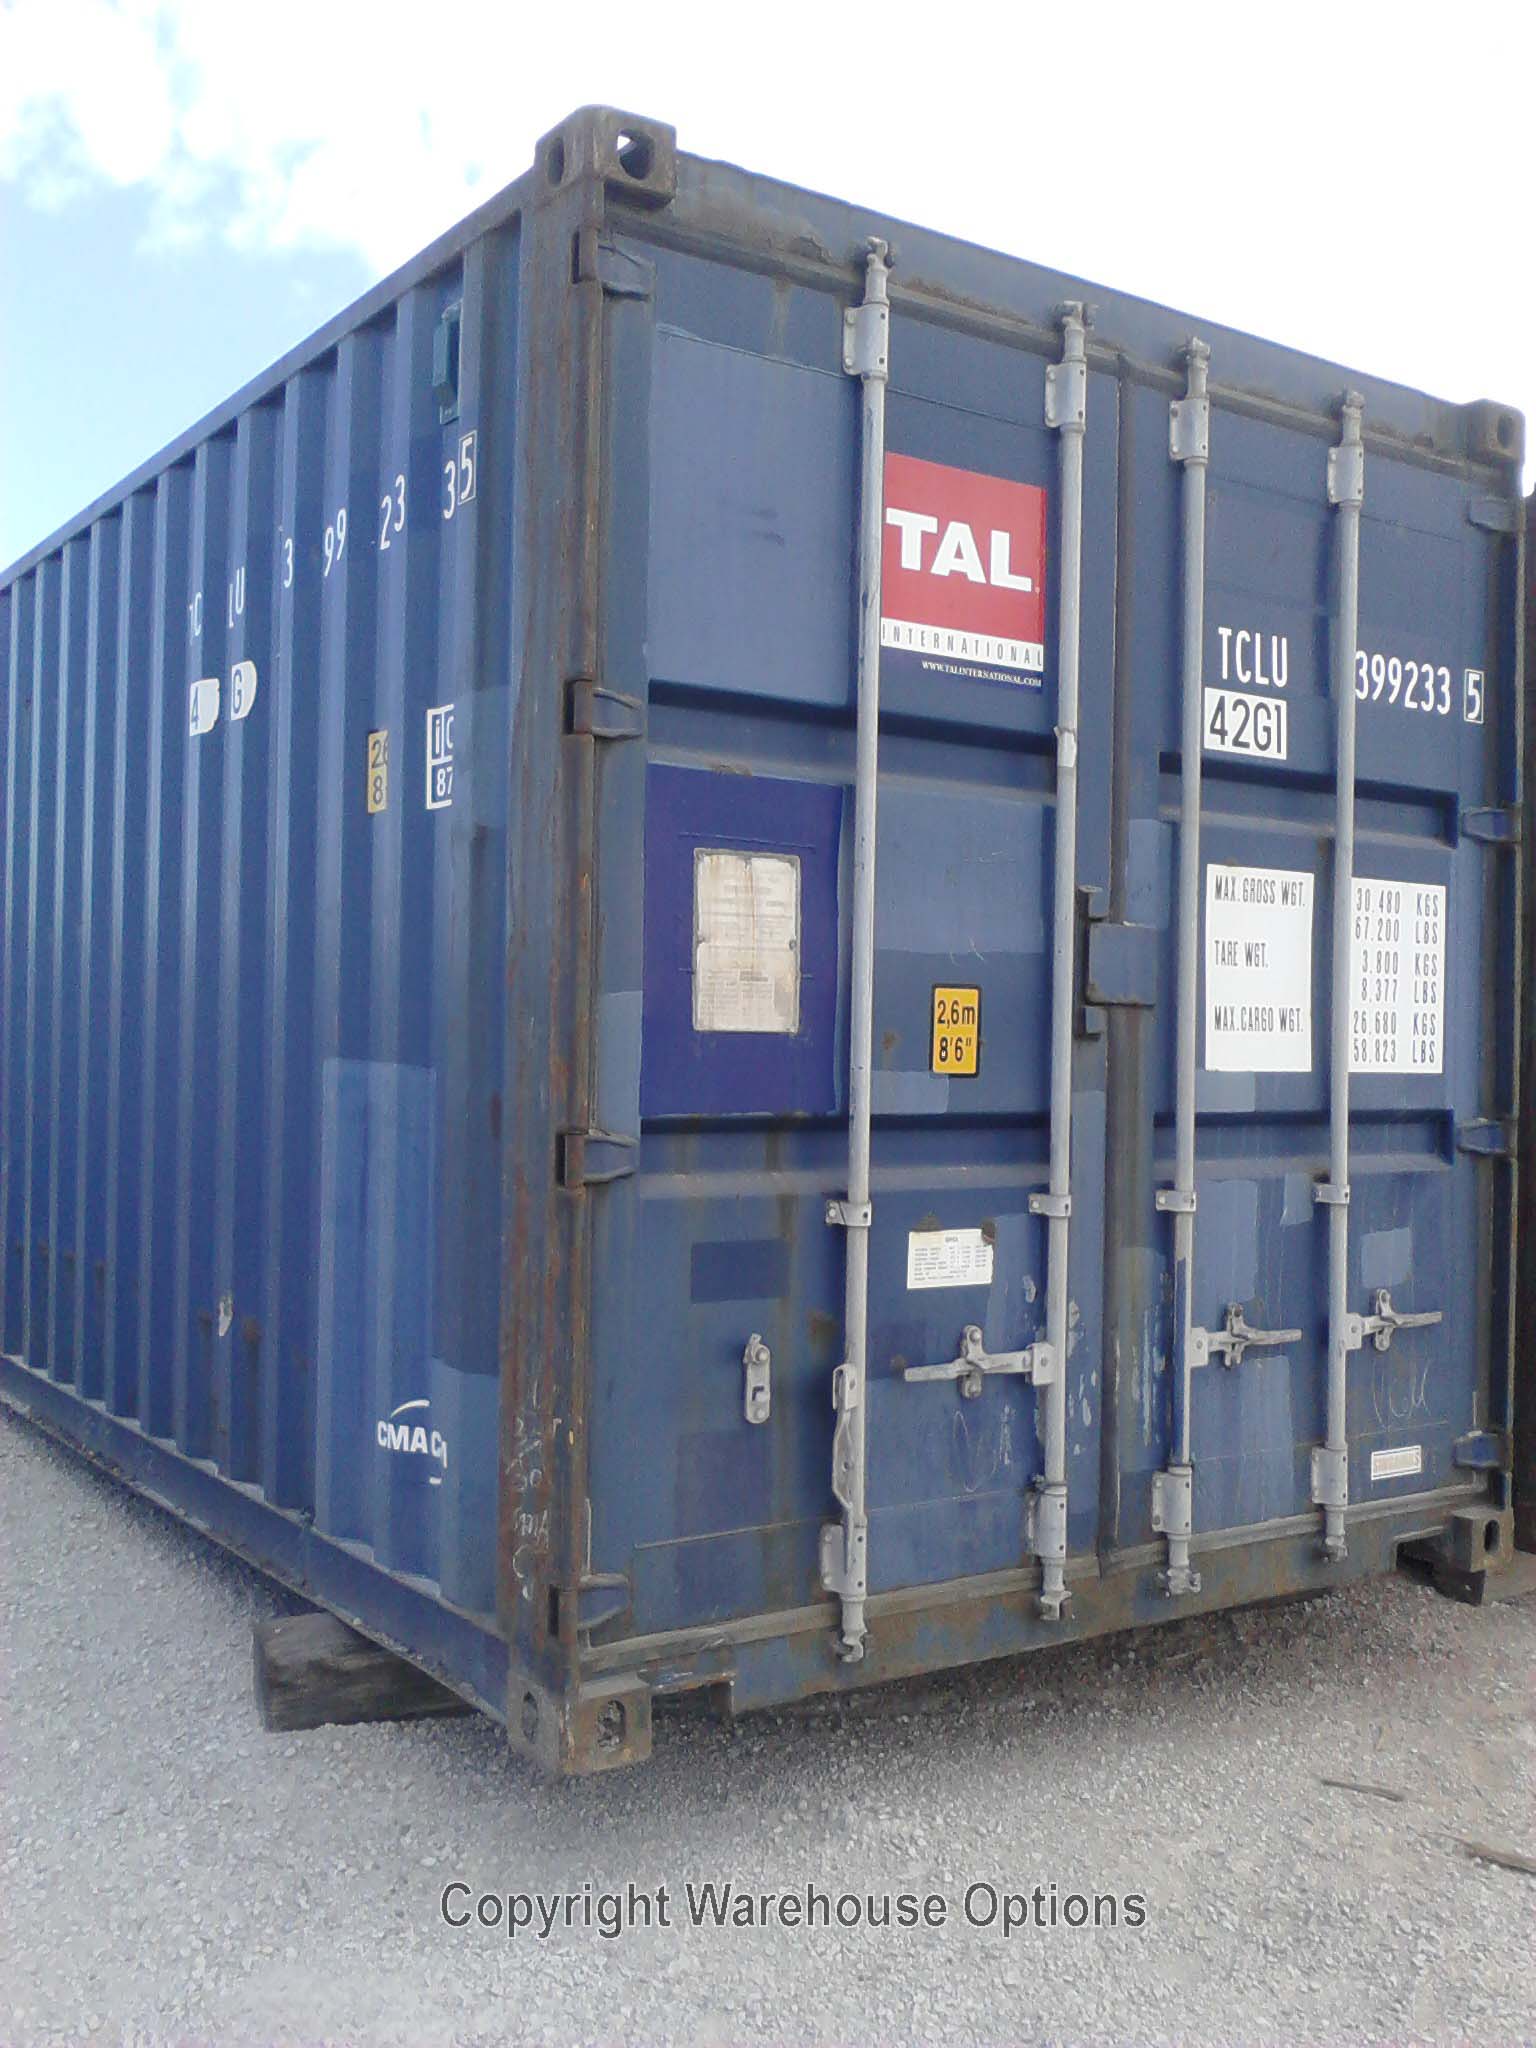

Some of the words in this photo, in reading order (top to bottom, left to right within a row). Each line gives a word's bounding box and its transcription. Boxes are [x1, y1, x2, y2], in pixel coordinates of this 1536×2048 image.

[886, 507, 1032, 592] TAL
[882, 623, 1042, 667] INTERNATIONAL
[1218, 626, 1288, 688] TCLU
[1355, 650, 1451, 715] 399233
[1466, 672, 1481, 720] 5
[1209, 695, 1282, 753] 42G1
[1416, 892, 1439, 918] KGS
[1355, 916, 1399, 942] 67.200
[1415, 921, 1438, 944] LBS
[1214, 940, 1239, 966] TARE
[1362, 949, 1399, 976] 3.800
[1414, 952, 1438, 977] KGS
[1361, 977, 1397, 1003] 8.377
[1414, 980, 1437, 1004] LBS
[1353, 1010, 1397, 1035] 26.680
[1412, 1012, 1436, 1036] KGS
[1353, 1038, 1397, 1064] 58.823
[1412, 1040, 1435, 1063] LBS
